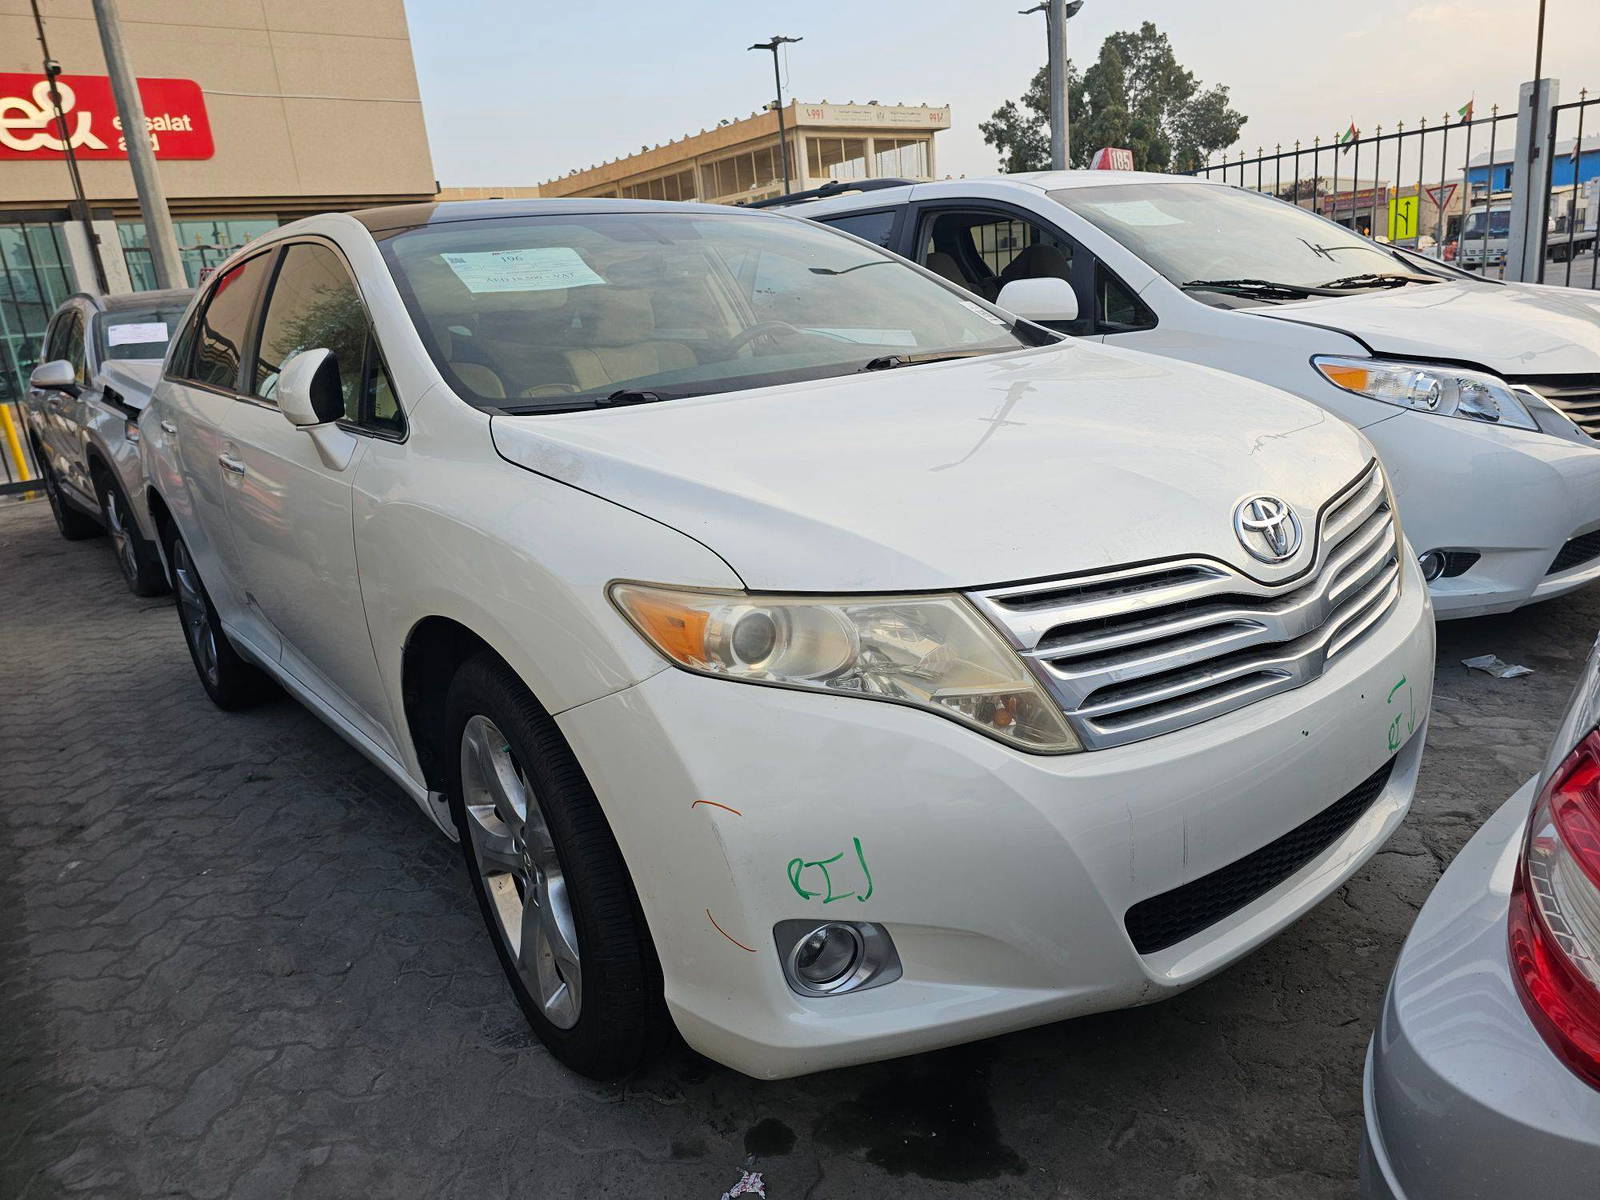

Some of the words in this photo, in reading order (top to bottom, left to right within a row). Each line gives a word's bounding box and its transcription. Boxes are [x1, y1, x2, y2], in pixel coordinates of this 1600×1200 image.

[112, 113, 193, 131] esalat
[118, 133, 160, 151] ad
[1112, 150, 1129, 170] 185
